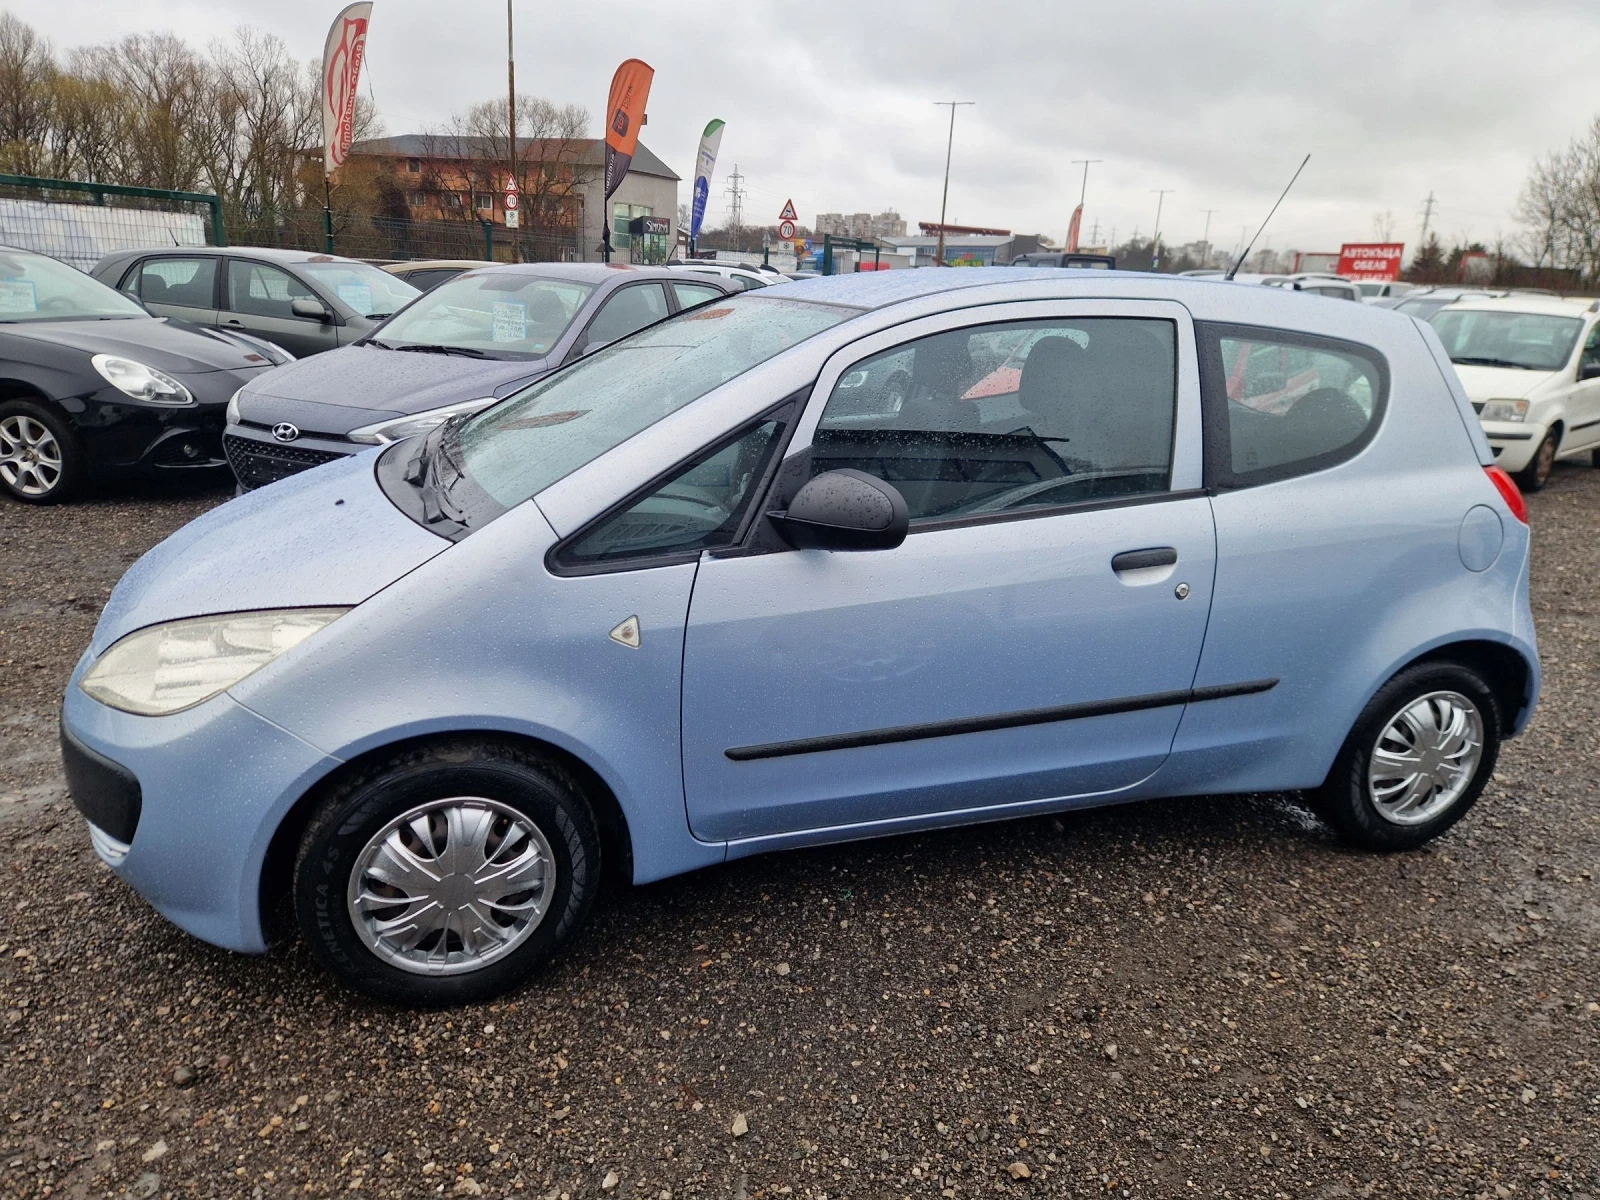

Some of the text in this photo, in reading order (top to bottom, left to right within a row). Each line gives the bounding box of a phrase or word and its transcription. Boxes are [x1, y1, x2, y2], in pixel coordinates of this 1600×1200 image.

[622, 84, 633, 110] bank
[508, 196, 516, 206] 70
[783, 225, 792, 236] 70
[1342, 247, 1401, 259] АВТОКЪЩА
